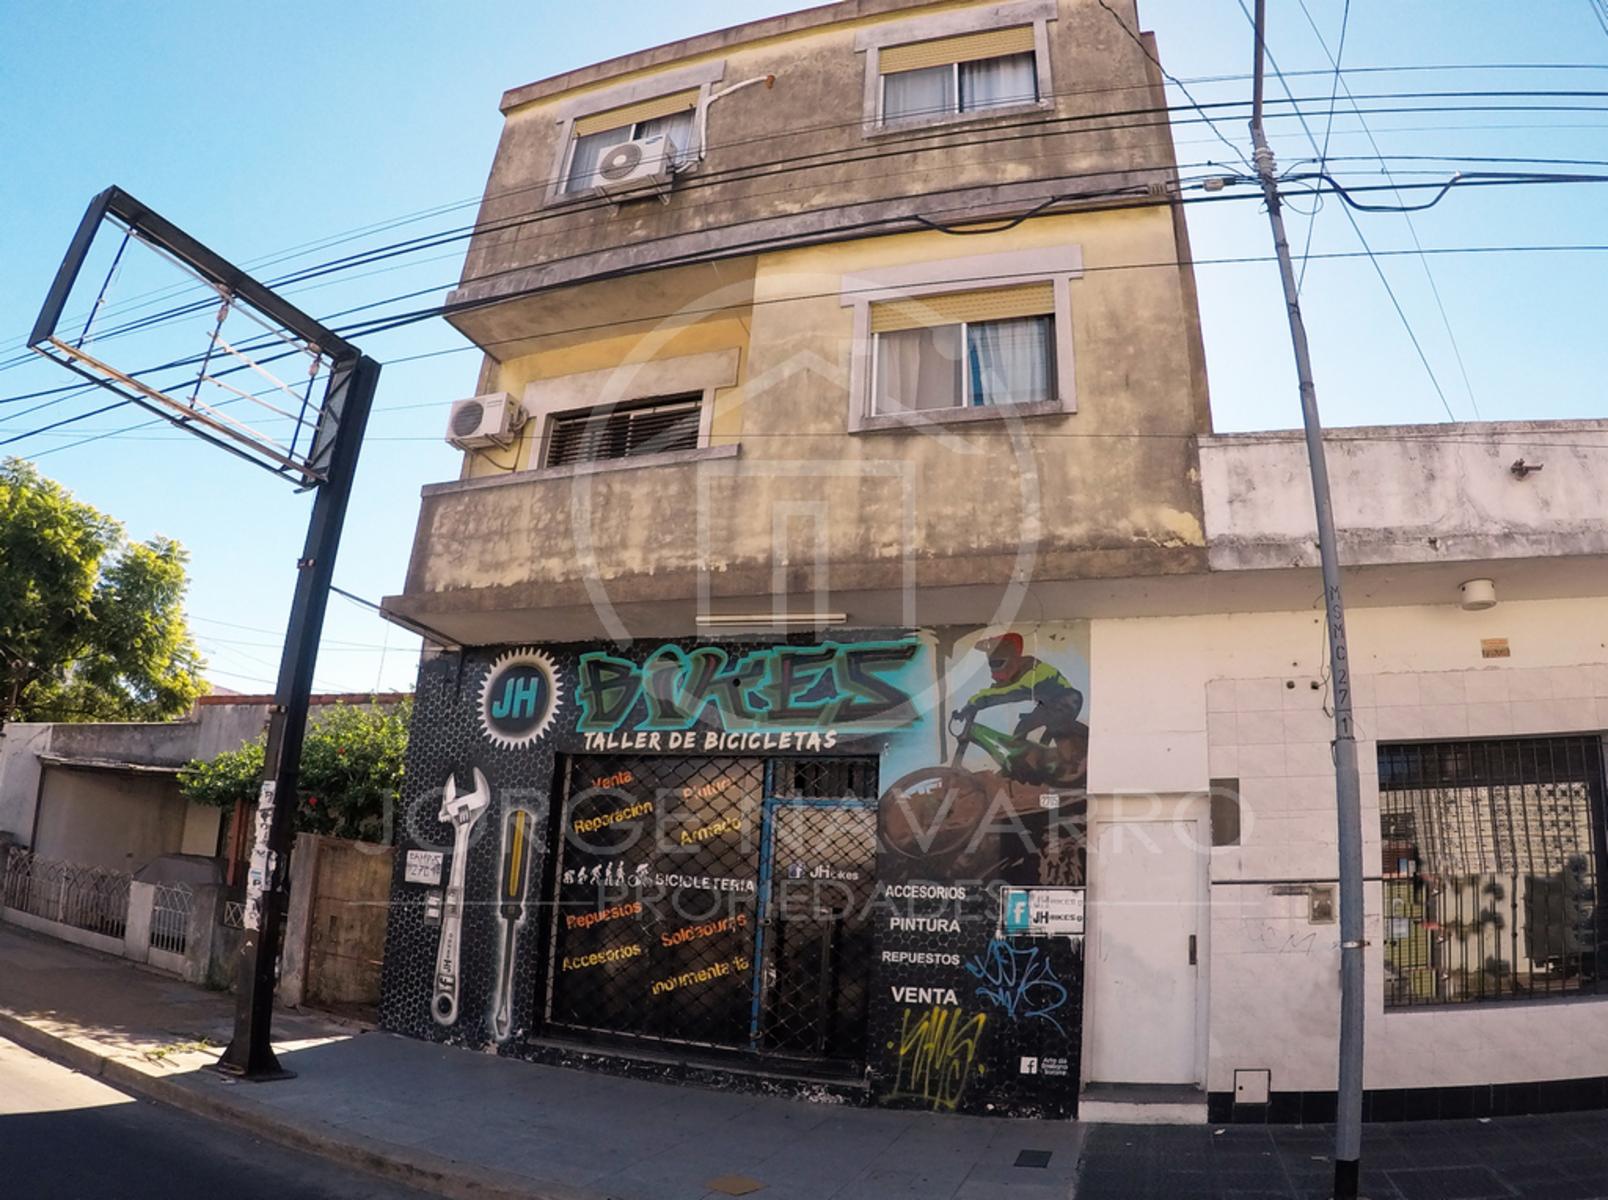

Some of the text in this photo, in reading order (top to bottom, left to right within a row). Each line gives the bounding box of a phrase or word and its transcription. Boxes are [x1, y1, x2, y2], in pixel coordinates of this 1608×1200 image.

[575, 639, 926, 733] BIKES
[492, 676, 540, 720] JH
[583, 729, 838, 751] TALLER DE BICICLETAS
[591, 770, 634, 790] Venta
[680, 818, 742, 846] Armado
[885, 884, 966, 900] ACCESORIOS
[890, 916, 961, 933] PINTURA
[882, 950, 960, 966] REPUESTOS
[891, 986, 958, 1005] VENTA
